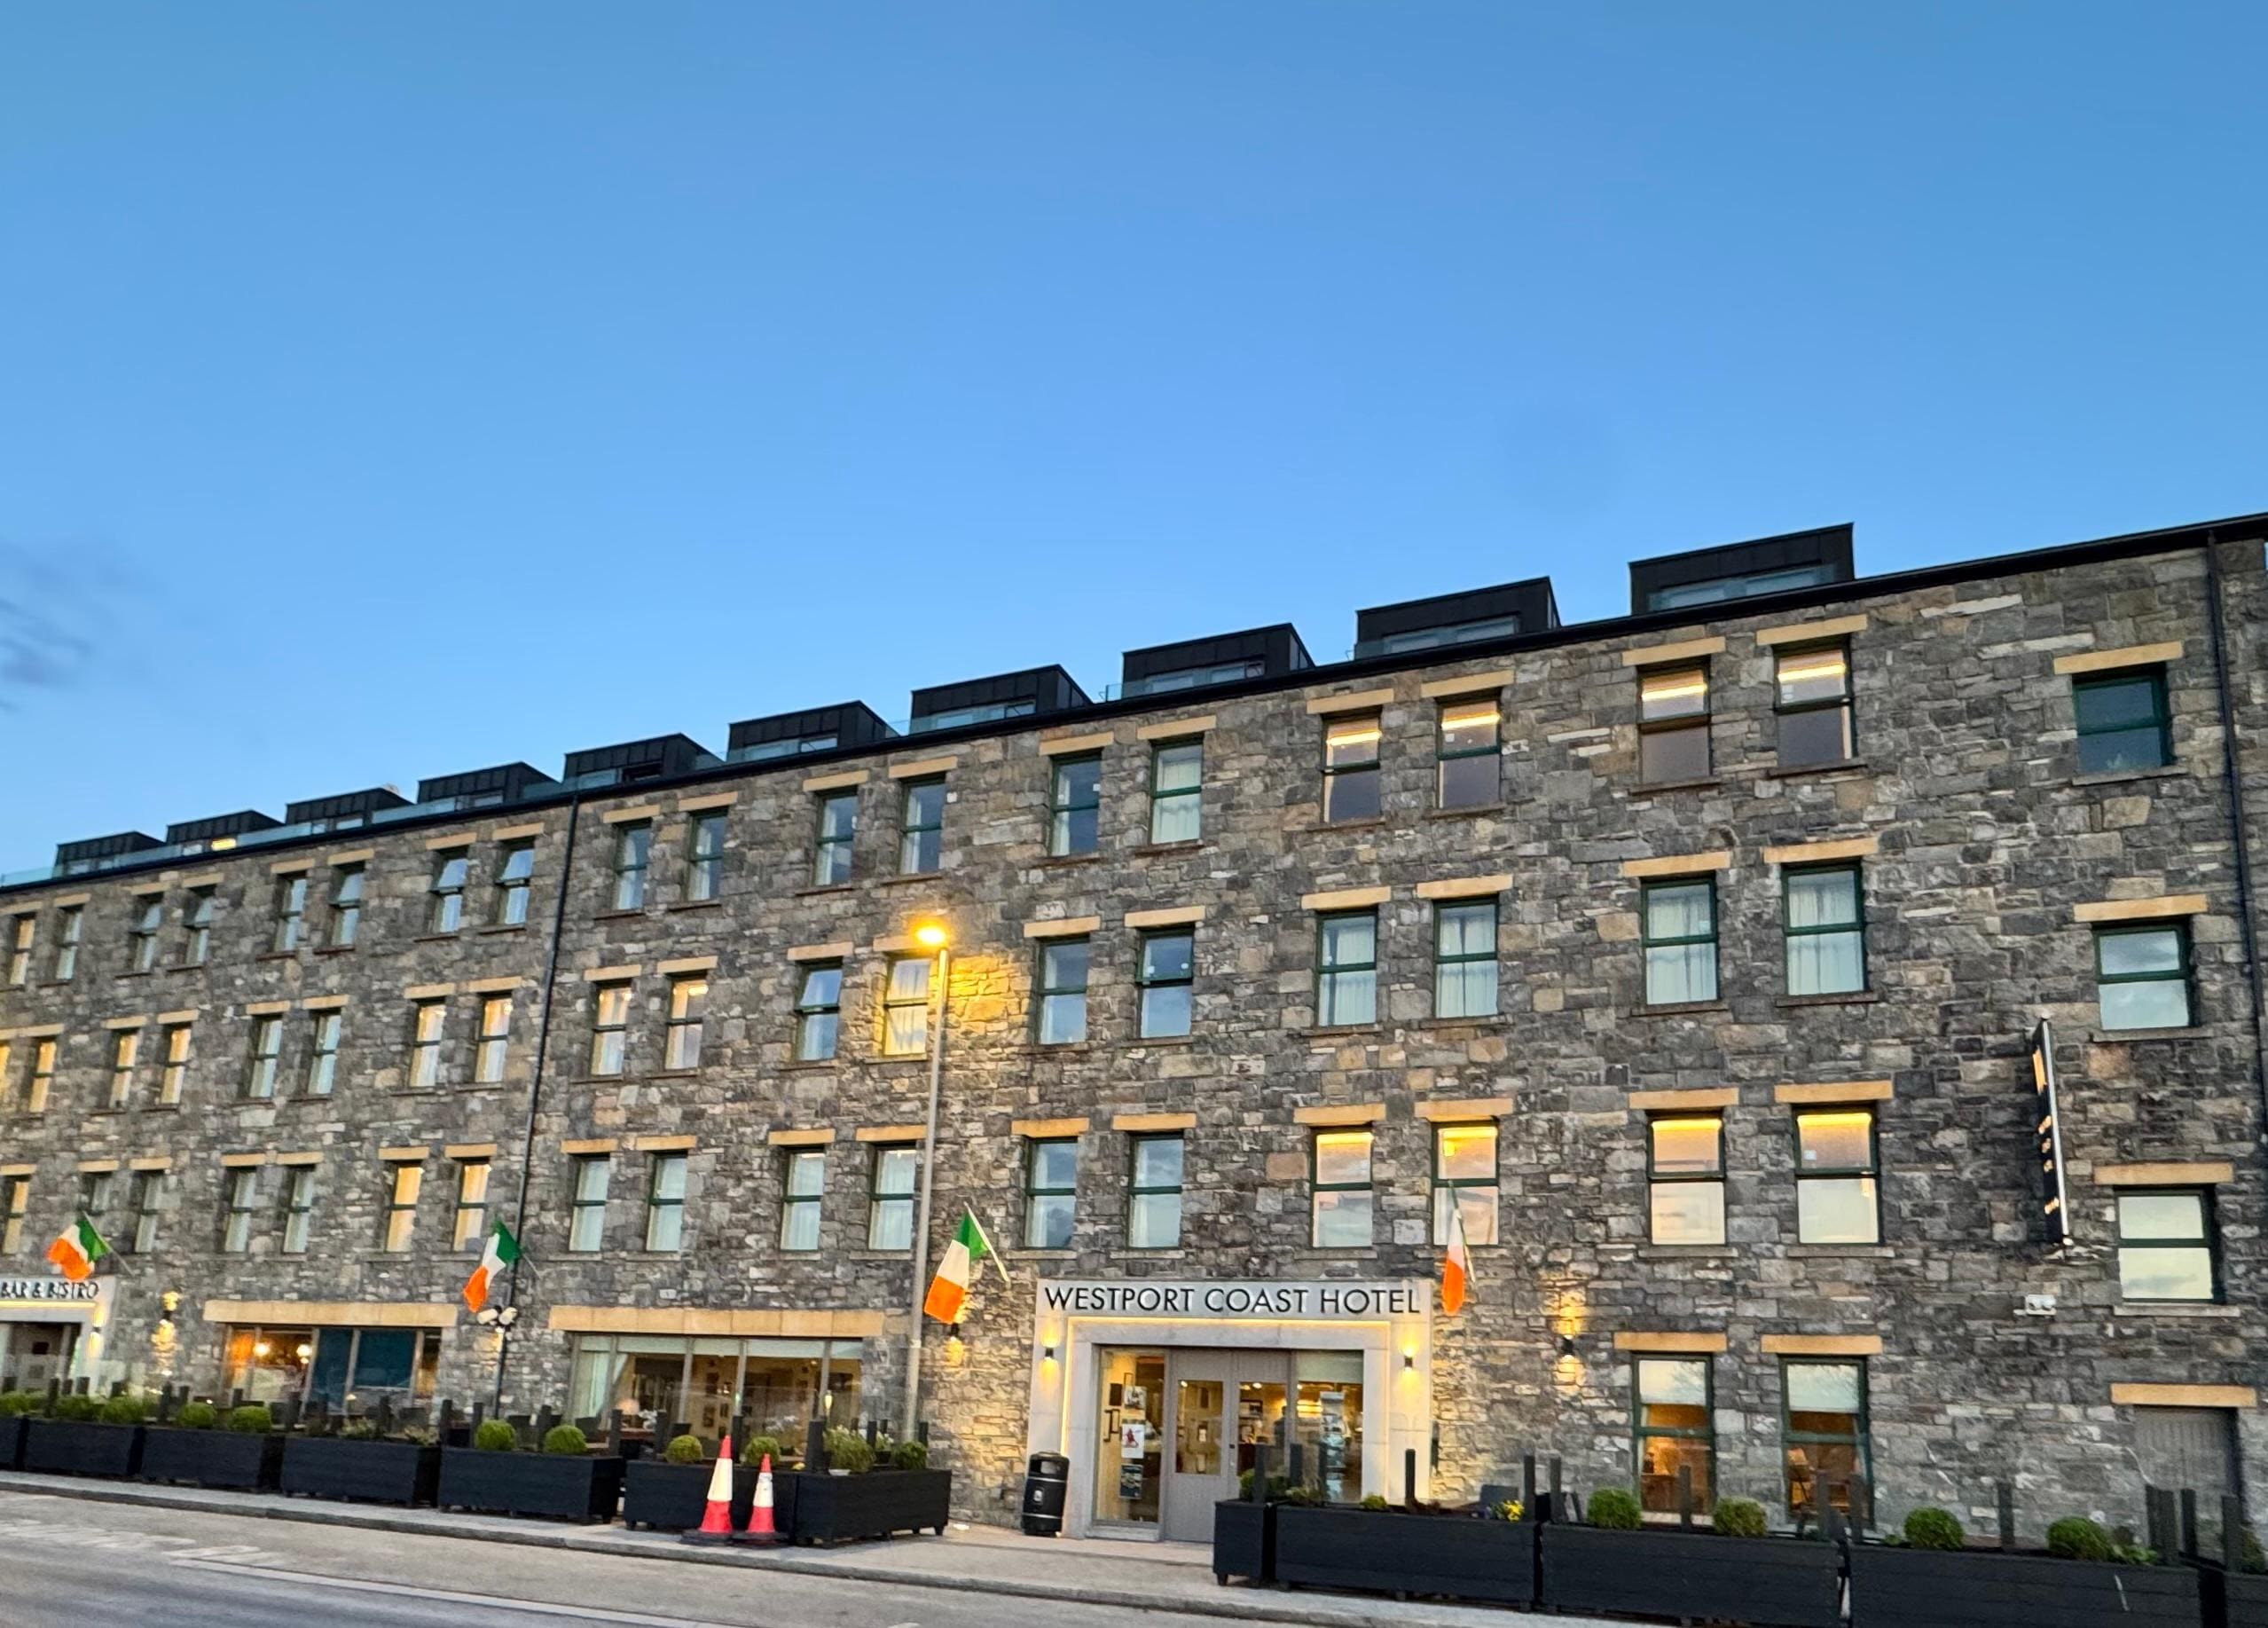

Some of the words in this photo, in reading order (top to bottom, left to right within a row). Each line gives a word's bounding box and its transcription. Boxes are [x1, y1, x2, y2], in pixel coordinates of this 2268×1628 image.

[48, 1281, 99, 1299] BISTRO
[1045, 1287, 1194, 1312] WESTPORT
[1205, 1288, 1308, 1313] COAST
[1320, 1289, 1420, 1313] HOTEL
